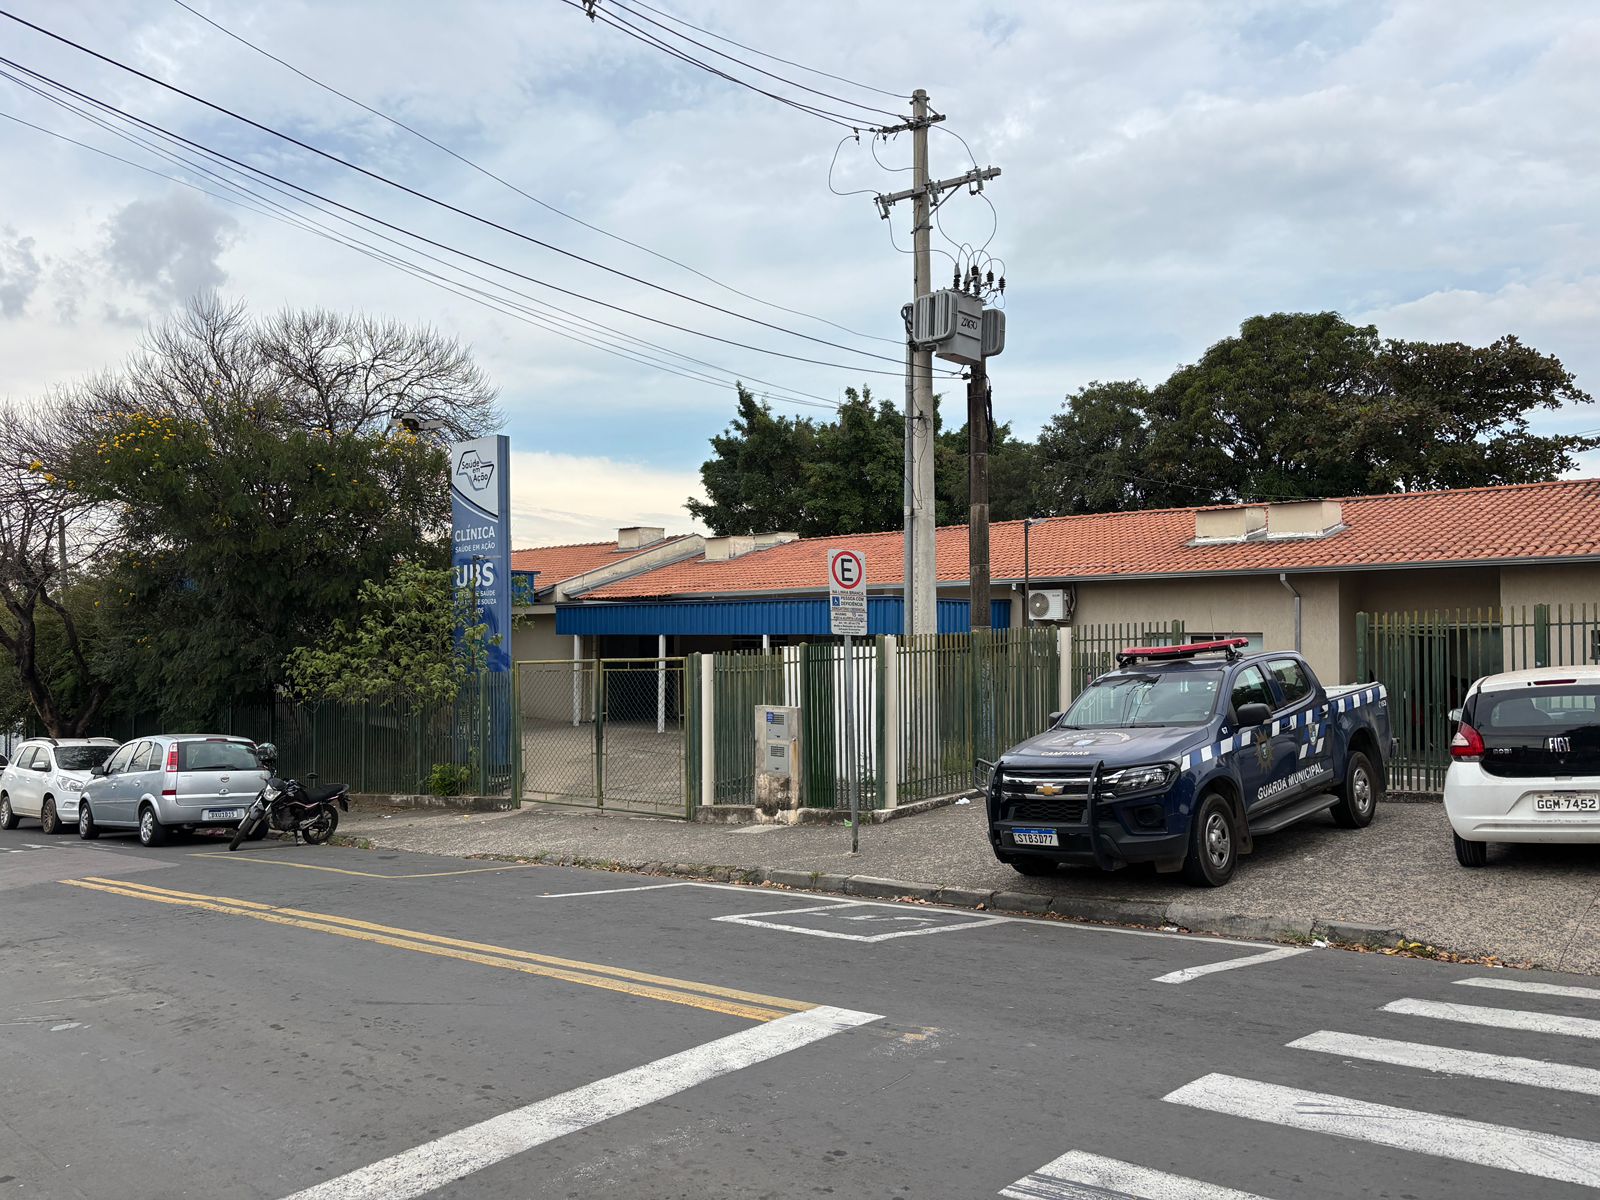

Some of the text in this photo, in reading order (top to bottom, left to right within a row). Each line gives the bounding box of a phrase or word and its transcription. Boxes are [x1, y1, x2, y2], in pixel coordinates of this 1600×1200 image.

[461, 459, 480, 470] Saúde
[473, 472, 489, 483] Ação
[454, 524, 496, 542] CLÍNICA
[454, 544, 472, 554] SAÚDE
[480, 541, 496, 551] AÇÃO
[456, 562, 495, 588] UBS
[840, 558, 853, 582] E
[480, 588, 496, 597] SAÚDE
[1548, 737, 1570, 752] FIAT
[1257, 762, 1324, 800] GUARDA MUNICIPAL
